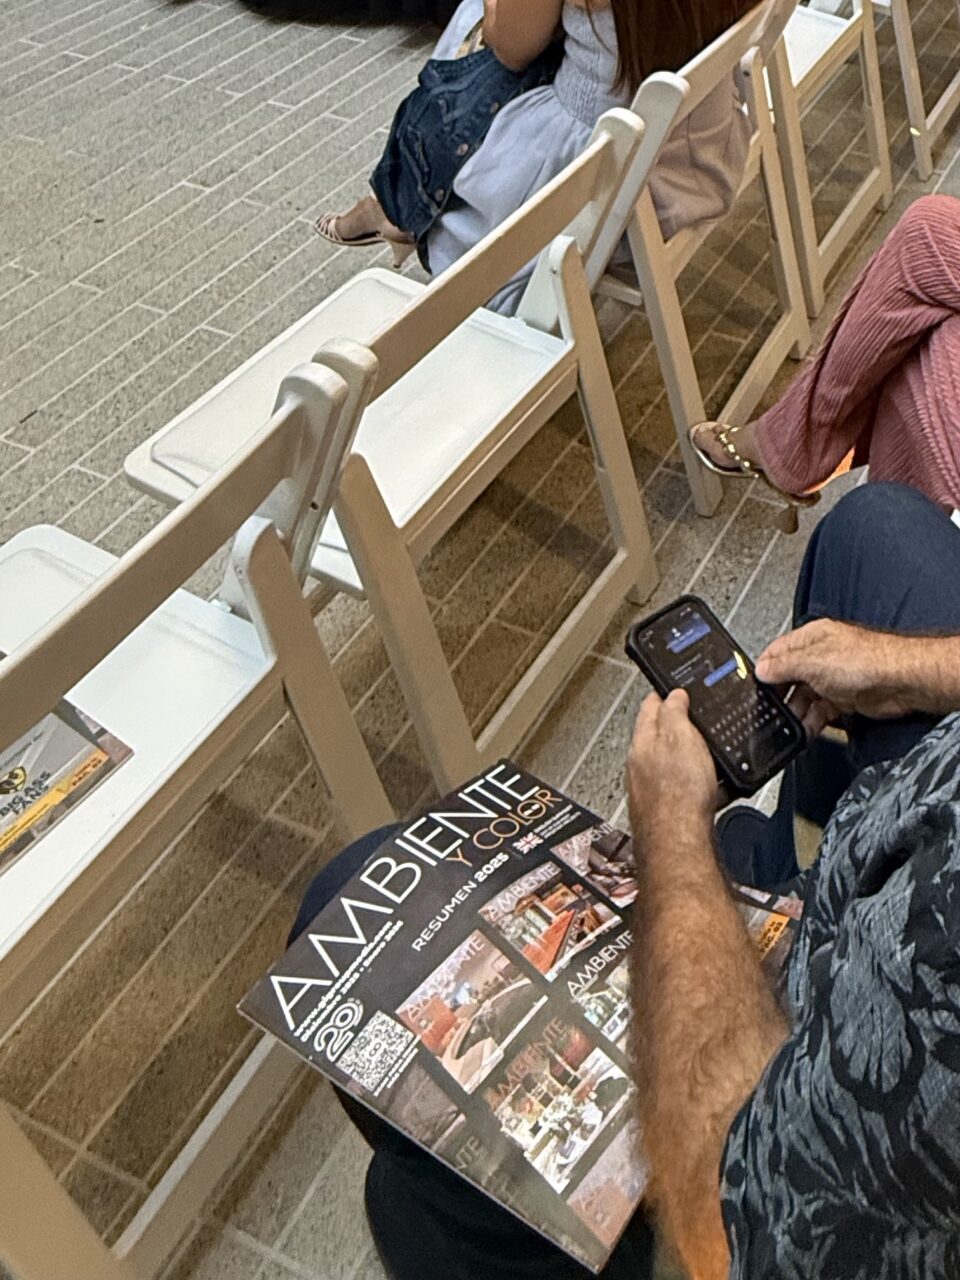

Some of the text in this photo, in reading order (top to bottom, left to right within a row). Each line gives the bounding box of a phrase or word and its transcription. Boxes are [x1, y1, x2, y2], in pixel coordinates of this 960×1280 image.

[0, 771, 51, 816] BIG ASS
[12, 785, 49, 815] FANS
[445, 847, 473, 868] Y
[473, 788, 563, 850] COLOR
[270, 764, 540, 1031] AMBIENTE
[411, 851, 510, 952] RESUMEN 2025
[491, 1017, 568, 1103] MBIENTE
